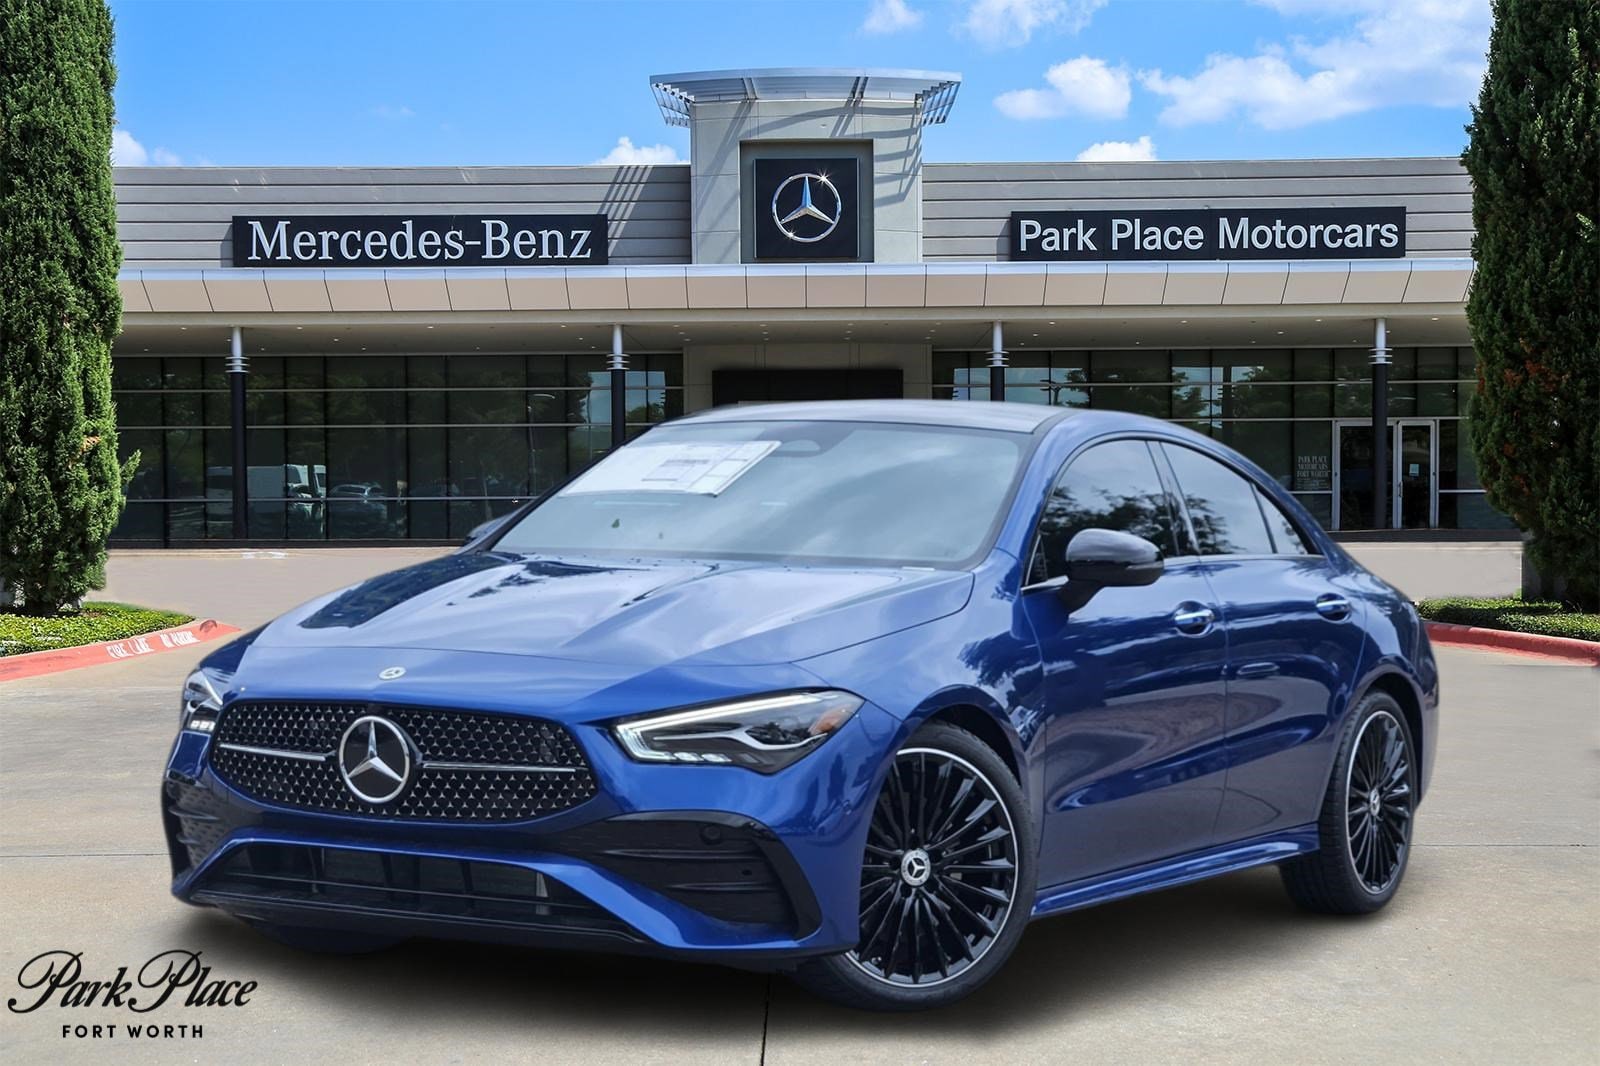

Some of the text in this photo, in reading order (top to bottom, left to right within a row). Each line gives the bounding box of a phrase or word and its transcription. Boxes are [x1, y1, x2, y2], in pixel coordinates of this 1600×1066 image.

[247, 219, 592, 261] Mercedes-Benz
[1019, 216, 1399, 251] Park Place Motorcars
